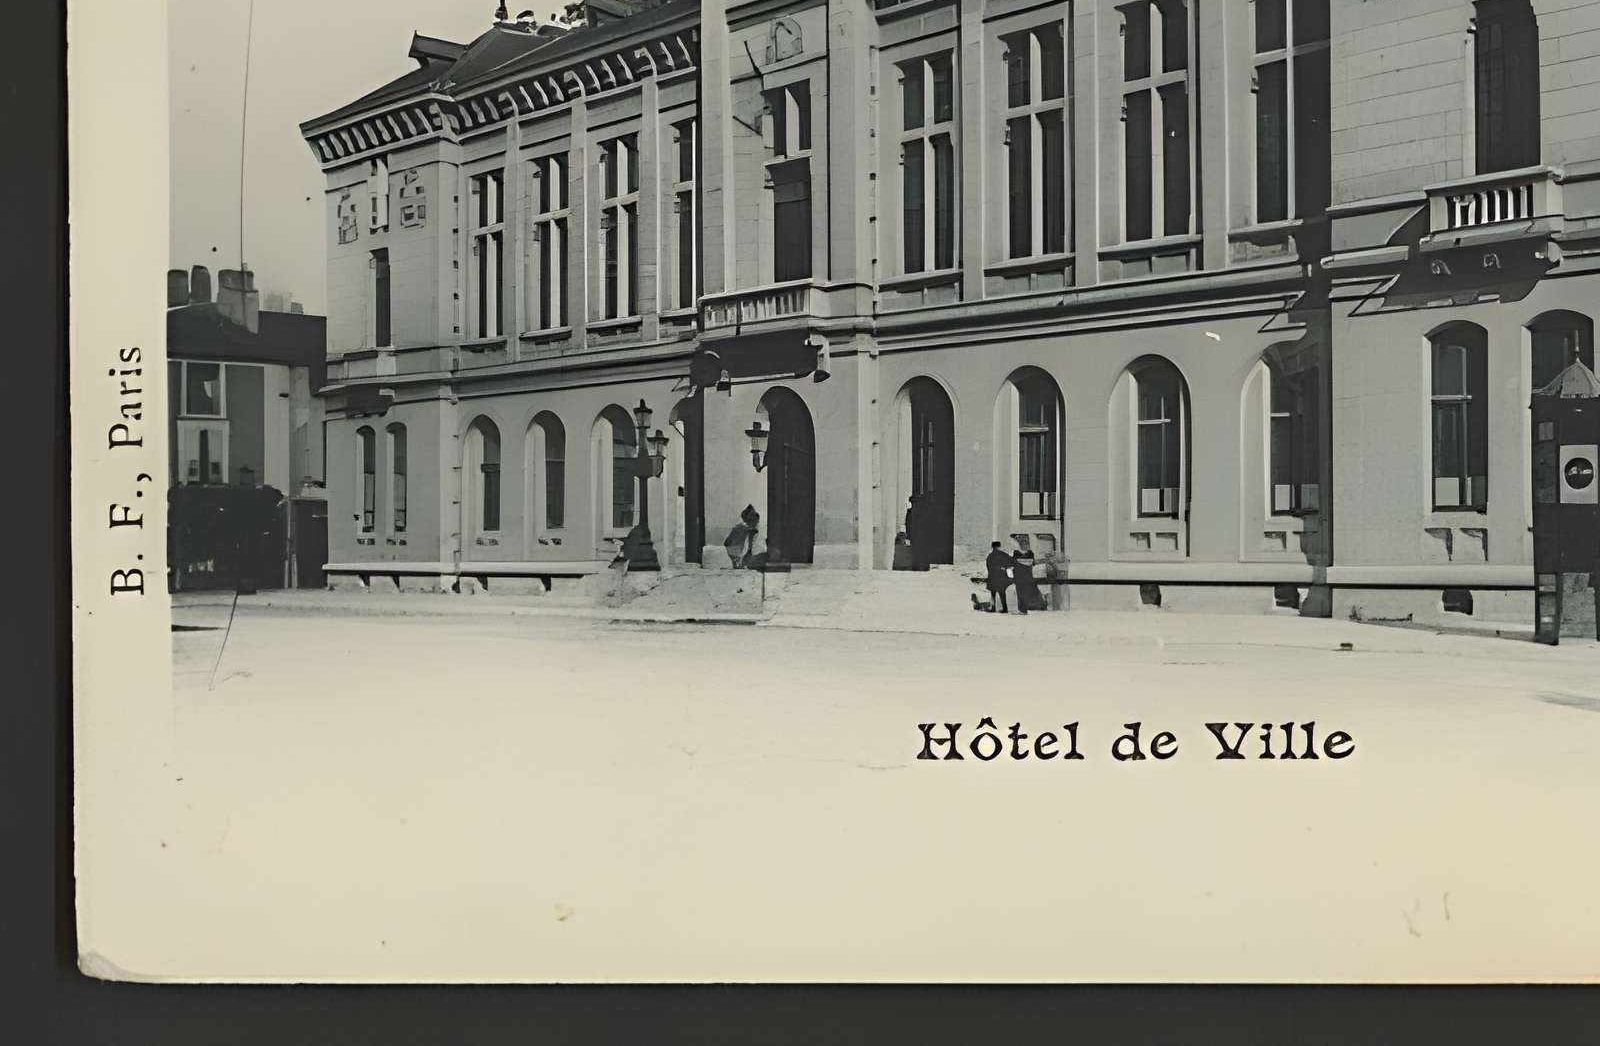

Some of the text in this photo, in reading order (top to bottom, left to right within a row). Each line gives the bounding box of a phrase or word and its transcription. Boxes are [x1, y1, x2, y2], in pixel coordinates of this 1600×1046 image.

[108, 346, 143, 451] Paris
[110, 553, 145, 596] B.
[916, 717, 1356, 761] Hôtel de Ville
